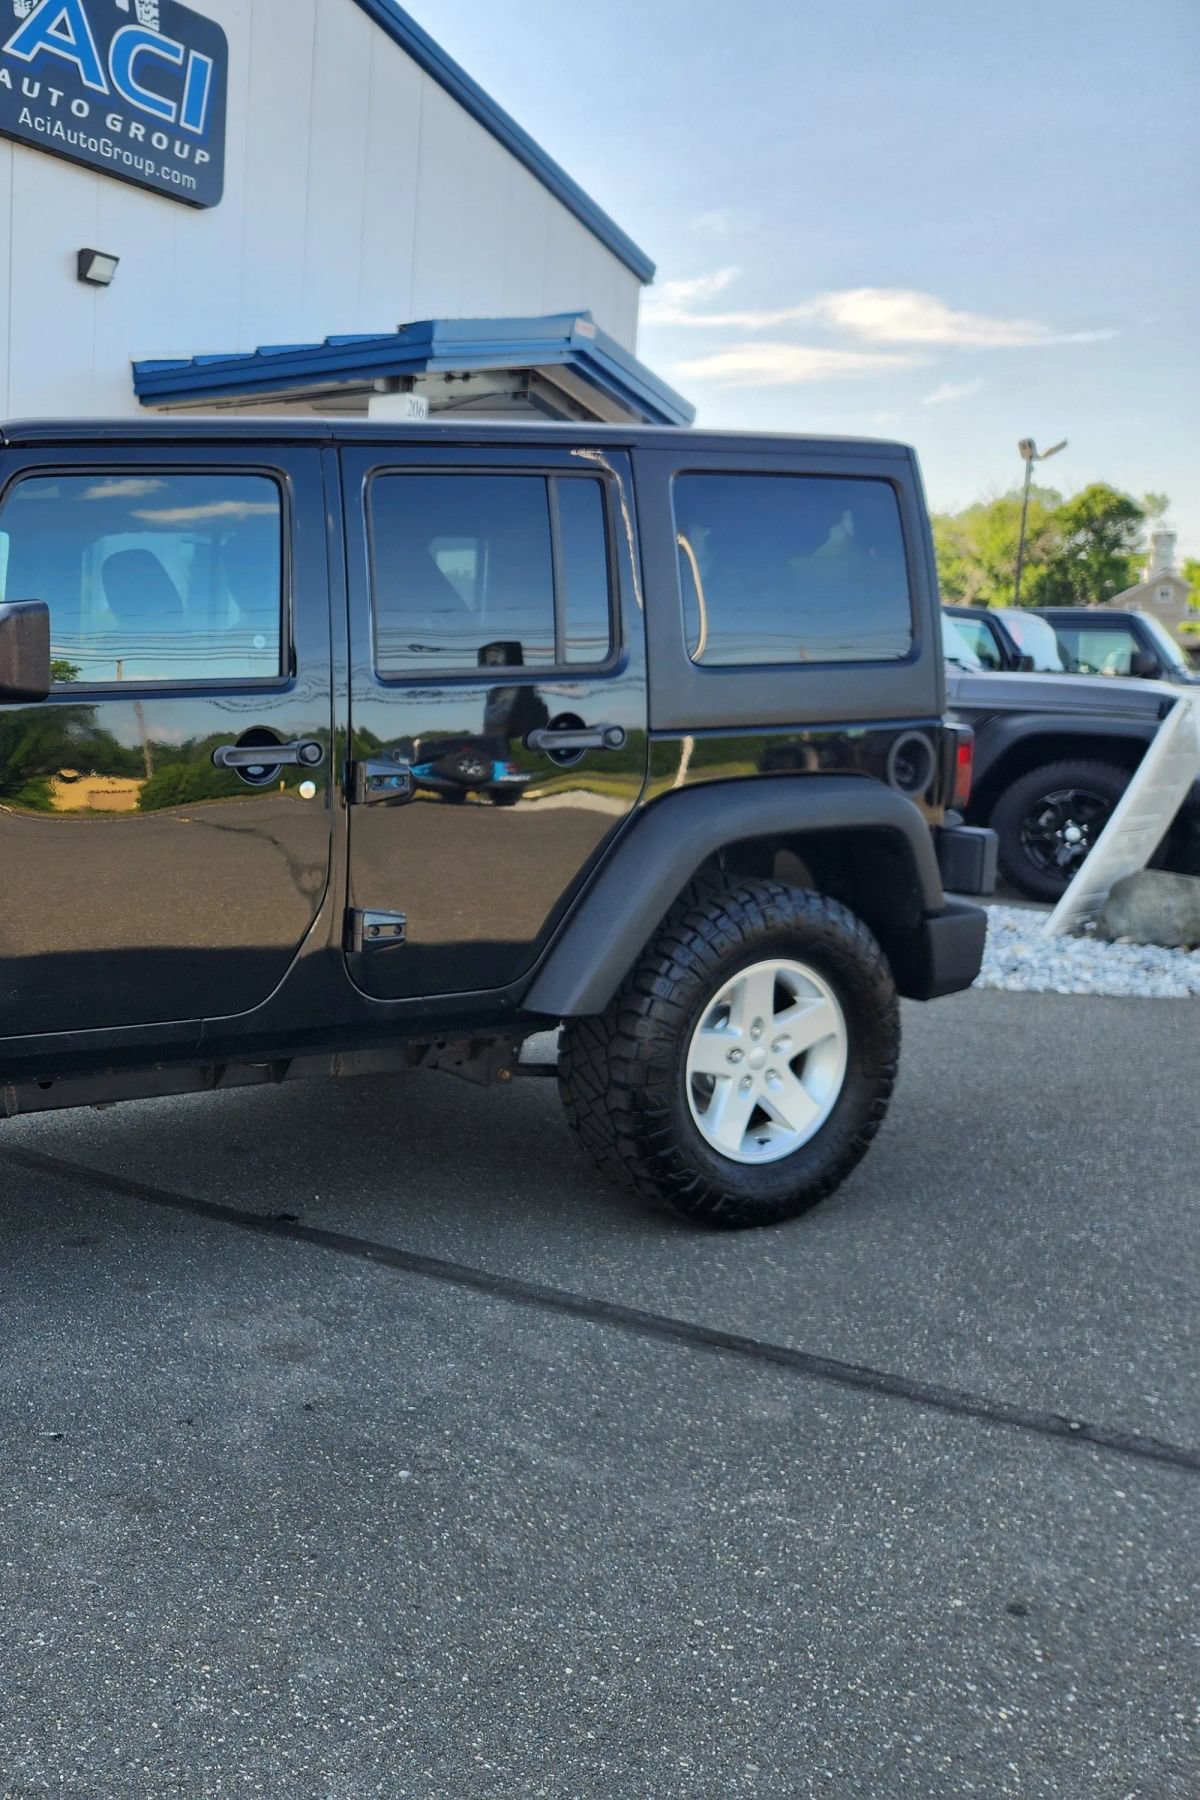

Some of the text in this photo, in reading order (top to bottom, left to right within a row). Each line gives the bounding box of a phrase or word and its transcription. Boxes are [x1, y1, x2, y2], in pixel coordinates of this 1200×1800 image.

[2, 0, 213, 135] ACI
[18, 107, 197, 190] AciAutoGroup.com
[105, 112, 211, 165] GROUP
